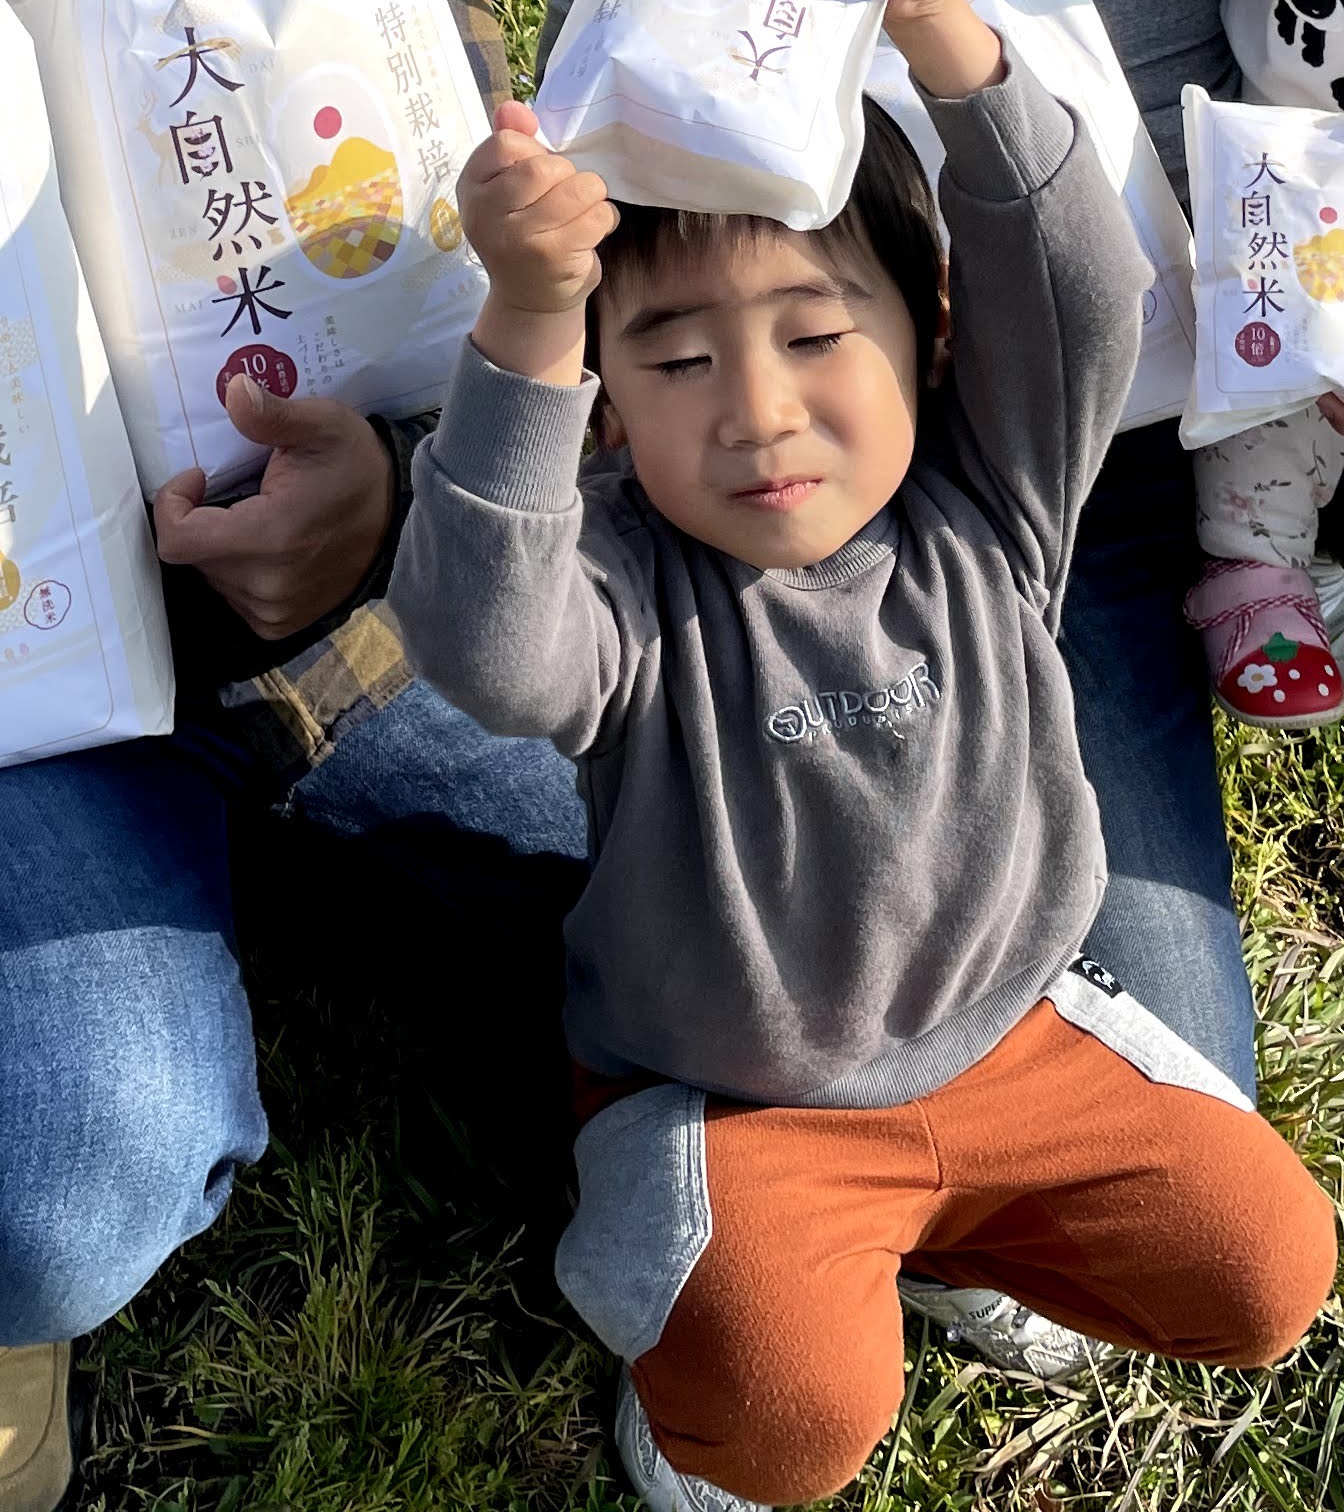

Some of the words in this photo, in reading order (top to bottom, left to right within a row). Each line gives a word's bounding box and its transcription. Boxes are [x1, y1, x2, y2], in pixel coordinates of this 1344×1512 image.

[374, 1, 452, 186] 特別栽培
[156, 26, 293, 338] 大自然米
[1241, 151, 1289, 318] 大自然米
[240, 353, 267, 377] 10
[1250, 327, 1266, 341] 10
[767, 661, 943, 742] OUTDOOR
